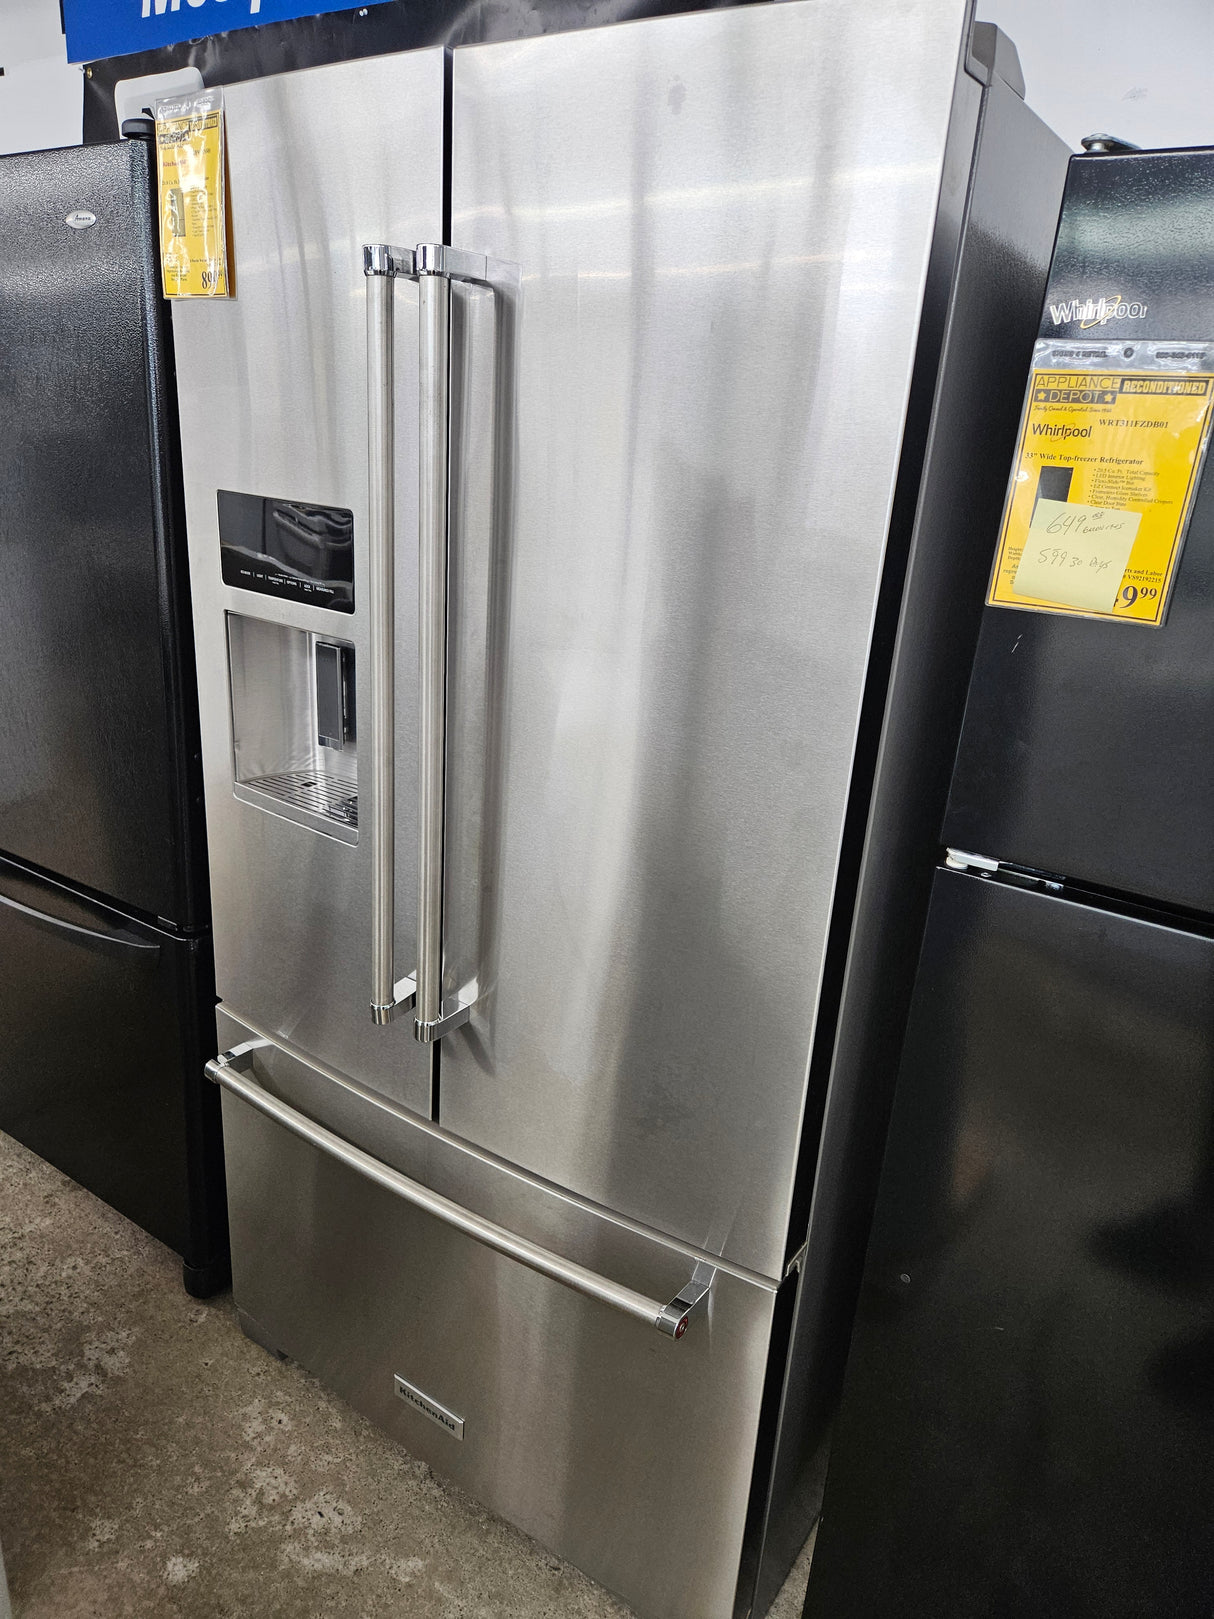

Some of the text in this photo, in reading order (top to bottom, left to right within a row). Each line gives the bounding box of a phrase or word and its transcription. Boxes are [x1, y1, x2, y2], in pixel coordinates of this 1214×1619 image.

[1050, 296, 1147, 326] Whirlpool
[1036, 376, 1120, 390] APPLIANCE
[1122, 380, 1207, 394] RECONDITIONED
[1049, 390, 1102, 403] DEPOT
[1099, 418, 1169, 429] WRT311FZDB01
[1032, 423, 1092, 440] Whirlpool
[1059, 454, 1097, 463] Top-freezer
[1100, 456, 1144, 465] Refrigerator
[1046, 512, 1087, 535] 649
[1038, 548, 1068, 567] 599
[399, 1386, 455, 1431] KitchenAid
